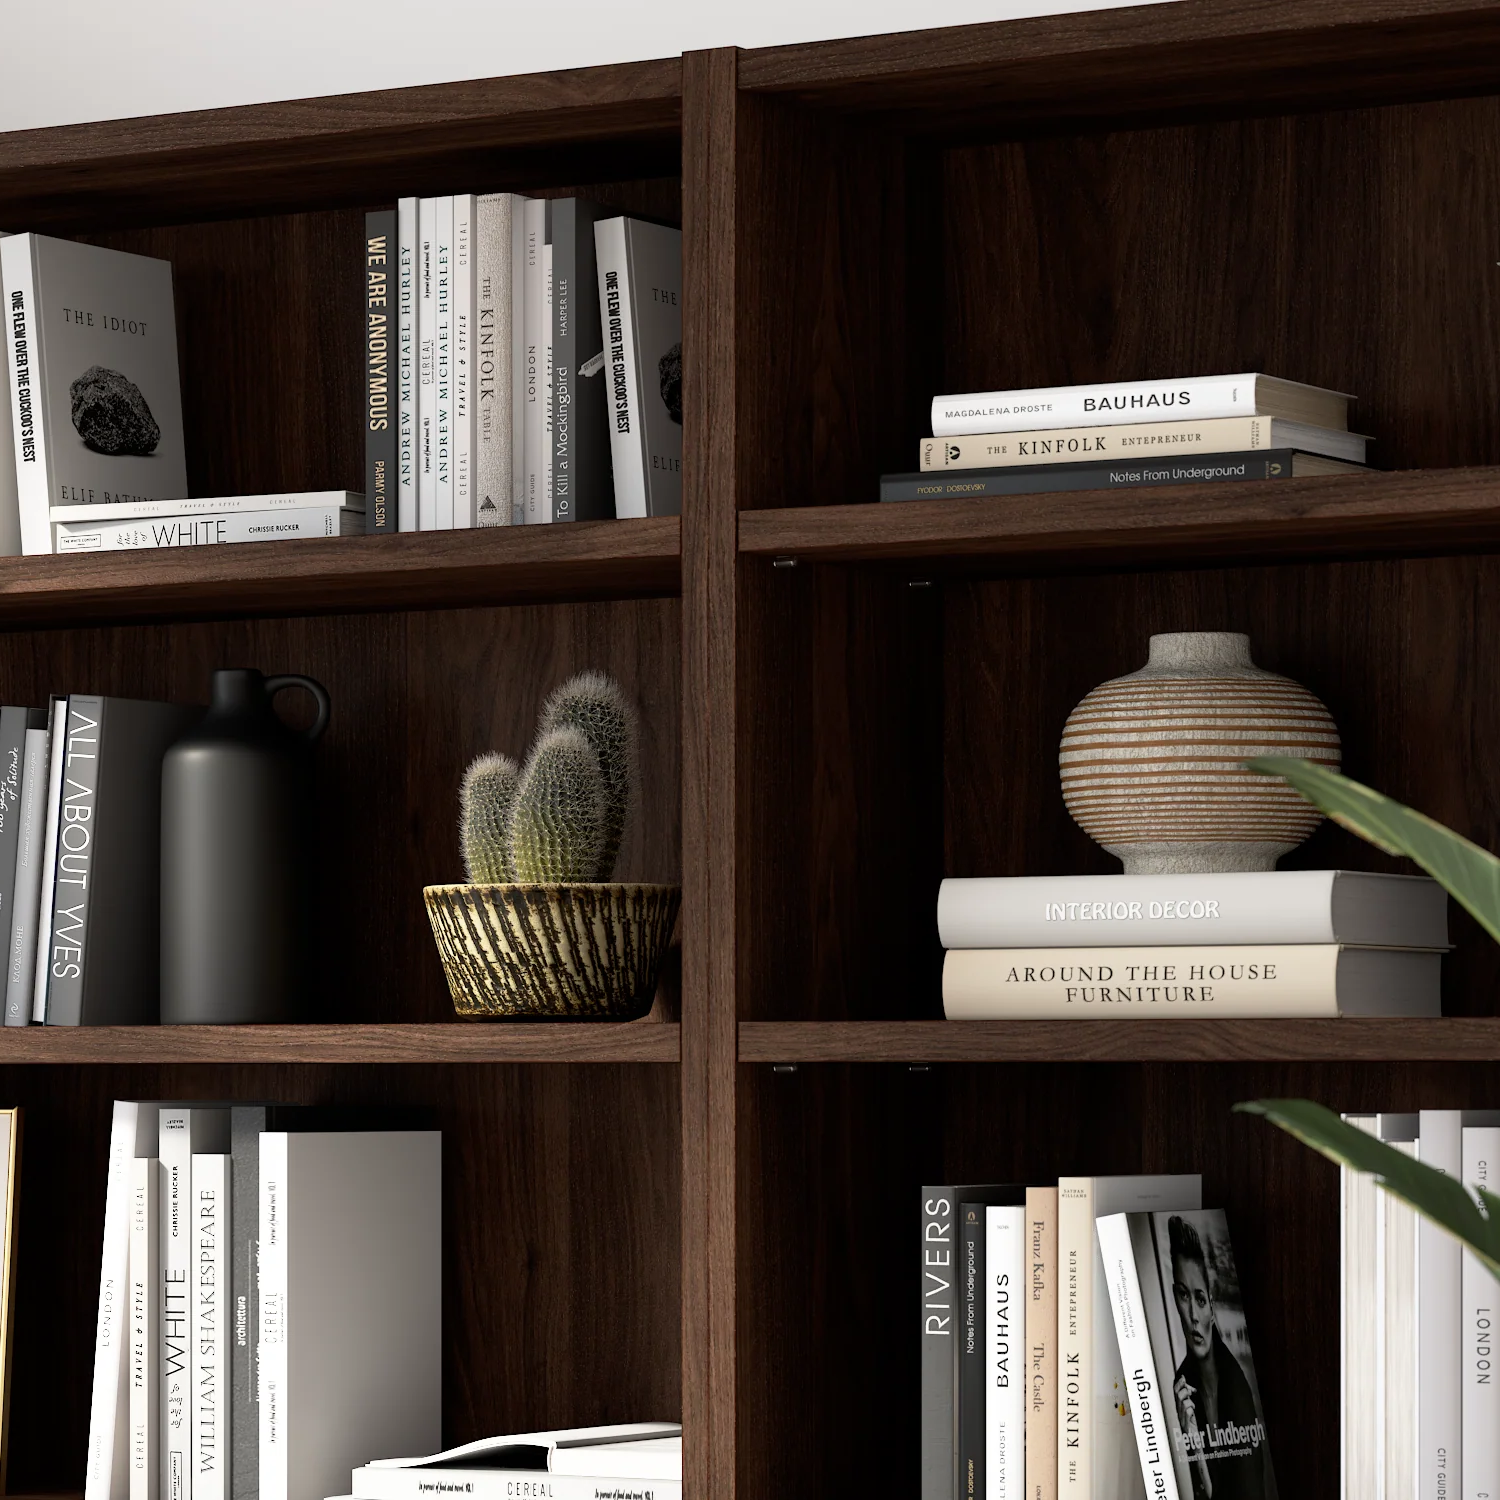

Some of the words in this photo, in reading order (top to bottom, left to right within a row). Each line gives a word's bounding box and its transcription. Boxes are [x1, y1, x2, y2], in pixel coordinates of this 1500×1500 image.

[367, 236, 387, 267] WE
[11, 290, 24, 311] ONE
[368, 271, 387, 309] ARE
[12, 312, 26, 339] FLEW
[63, 308, 94, 327] THE
[103, 315, 148, 336] IDIOT
[15, 340, 28, 367] OVER
[17, 367, 30, 388] THE
[368, 313, 388, 431] ANONYMOUS
[528, 346, 536, 403] LONDON
[556, 366, 571, 457] Mockingbird
[1084, 391, 1191, 412] BAUHAUS
[22, 438, 36, 463] NEST
[987, 446, 1008, 455] THE
[1018, 437, 1107, 456] KINFOLK
[1121, 433, 1202, 446] ENTEPRENEUR
[374, 460, 385, 494] PARMY
[559, 460, 568, 470] a
[1110, 471, 1141, 483] Notes
[1143, 469, 1170, 481] From
[1172, 464, 1245, 479] Underground
[556, 474, 568, 496] Kill
[375, 495, 386, 528] OLSON
[556, 500, 569, 518] To
[152, 519, 227, 548] WHITE
[67, 710, 98, 768] ALL
[7, 747, 19, 786] Solitude
[0, 780, 9, 812] years
[7, 789, 18, 801] of
[59, 778, 93, 890] ABOUT
[1045, 901, 1144, 922] INTERIOR
[1149, 900, 1220, 920] DECOR
[52, 903, 85, 979] YVES
[1005, 965, 1114, 983] AROUND
[1125, 965, 1177, 982] THE
[1188, 963, 1278, 981] HOUSE
[1066, 985, 1215, 1003] FURNITURE
[1033, 1221, 1045, 1259] Franz
[200, 1190, 216, 1356] SHAKESPEARE
[925, 1198, 951, 1335] RIVERS
[1033, 1263, 1045, 1301] Kafka
[1069, 1250, 1077, 1336] ENTEPRENEUR
[165, 1269, 186, 1376] WHITE
[997, 1274, 1009, 1388] BAUHAUS
[1033, 1343, 1045, 1371] The
[1476, 1308, 1490, 1385] LONDON
[1033, 1374, 1045, 1413] Castle
[1067, 1352, 1080, 1448] KINFOLK
[200, 1365, 215, 1474] WILLIAM
[1132, 1368, 1160, 1464] Lindbergh
[1173, 1426, 1206, 1451] Peter
[1207, 1417, 1266, 1449] Lindbergh
[507, 1481, 554, 1498] CEREAL
